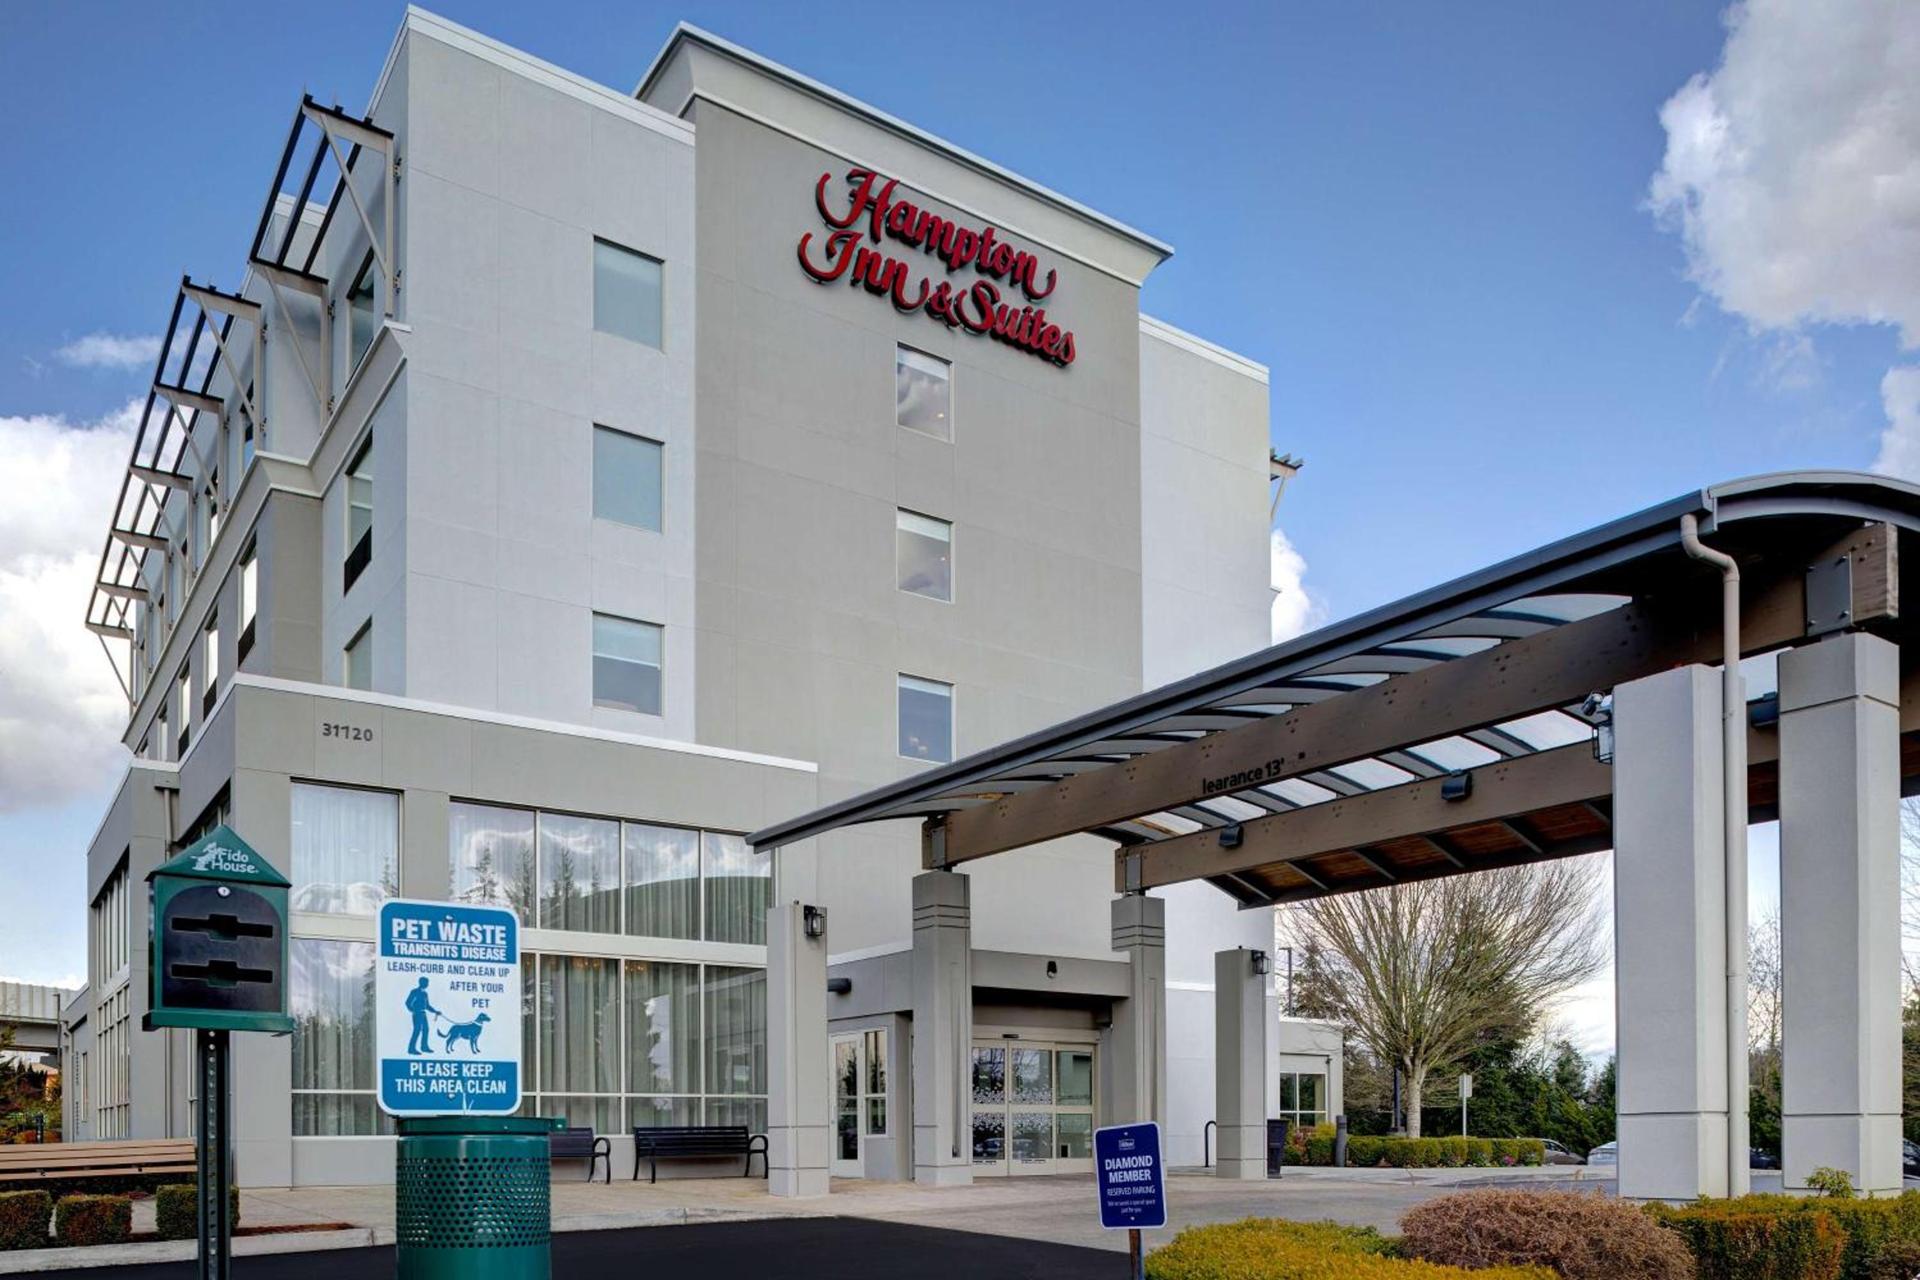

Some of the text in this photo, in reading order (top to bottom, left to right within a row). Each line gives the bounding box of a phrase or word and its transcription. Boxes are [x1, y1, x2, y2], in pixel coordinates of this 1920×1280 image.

[815, 168, 1057, 301] Hampton
[798, 230, 1077, 367] Inn & Suites
[217, 847, 249, 863] Fido
[211, 859, 256, 873] House
[392, 918, 507, 945] PET WASTE
[393, 942, 507, 961] TRANSMITS DISEASE
[387, 961, 510, 978] LEASH-CURB AND CLEAN UP
[450, 981, 504, 993] AFTER YOUR
[472, 998, 491, 1009] PET
[410, 1062, 493, 1078] PLEASE KEEP
[395, 1078, 507, 1095] THIS AREA CLEAN
[1105, 1155, 1153, 1171] DIAMOND
[1109, 1169, 1152, 1184] MEMBER
